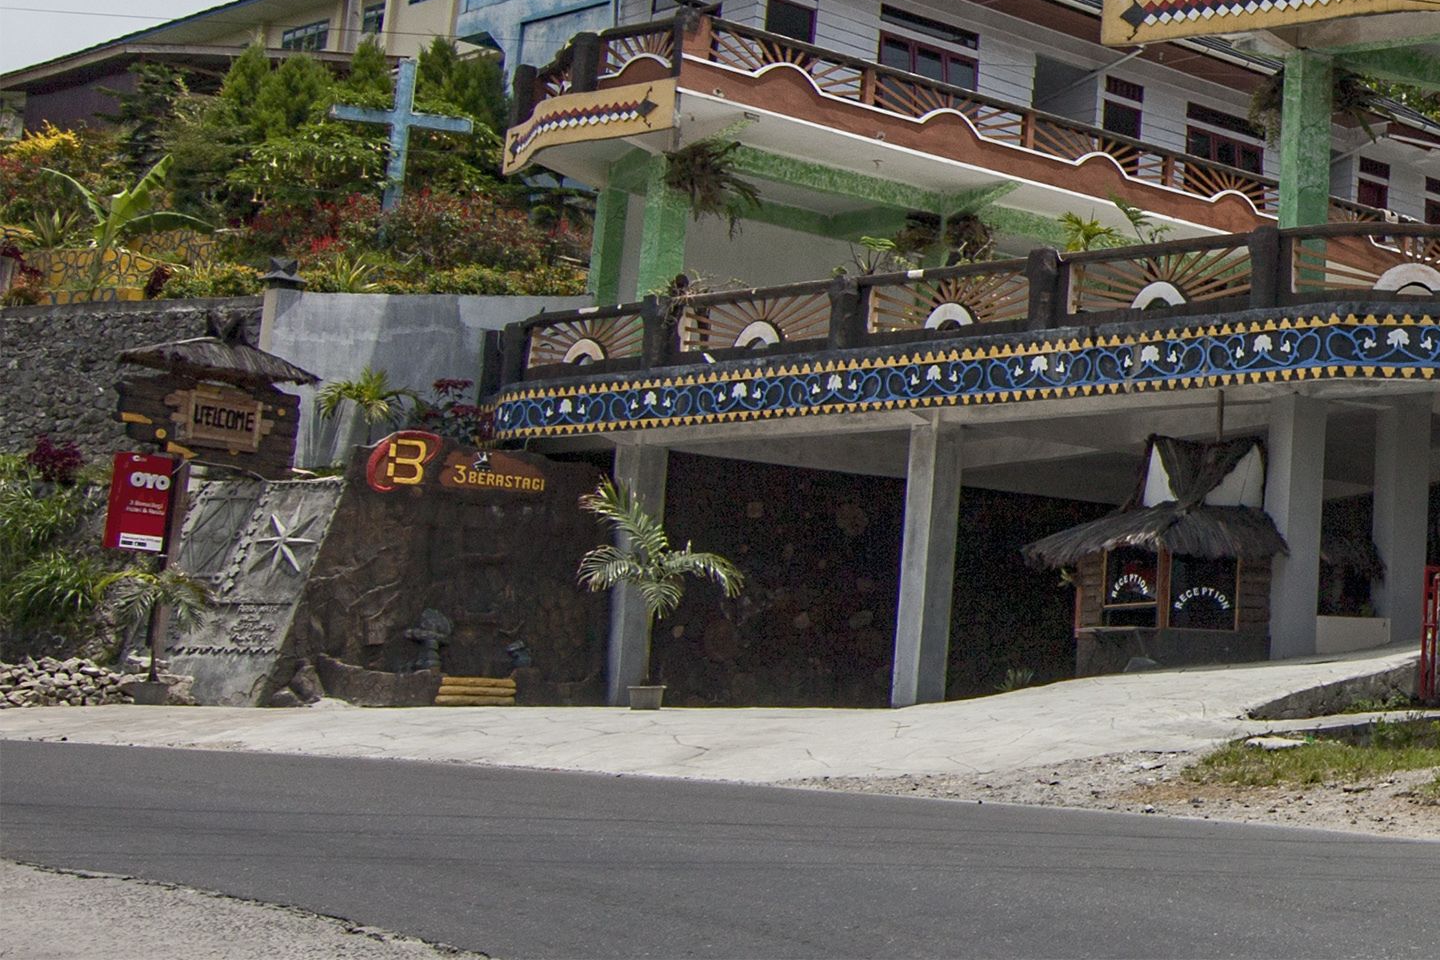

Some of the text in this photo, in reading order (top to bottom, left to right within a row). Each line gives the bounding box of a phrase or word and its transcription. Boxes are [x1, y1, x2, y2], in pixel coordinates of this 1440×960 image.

[194, 404, 255, 432] WELCOME
[131, 472, 170, 490] OYO
[453, 465, 545, 491] 3 BERASTAGI
[1111, 573, 1149, 598] RECEPTION
[1174, 586, 1230, 609] RECEPTION
